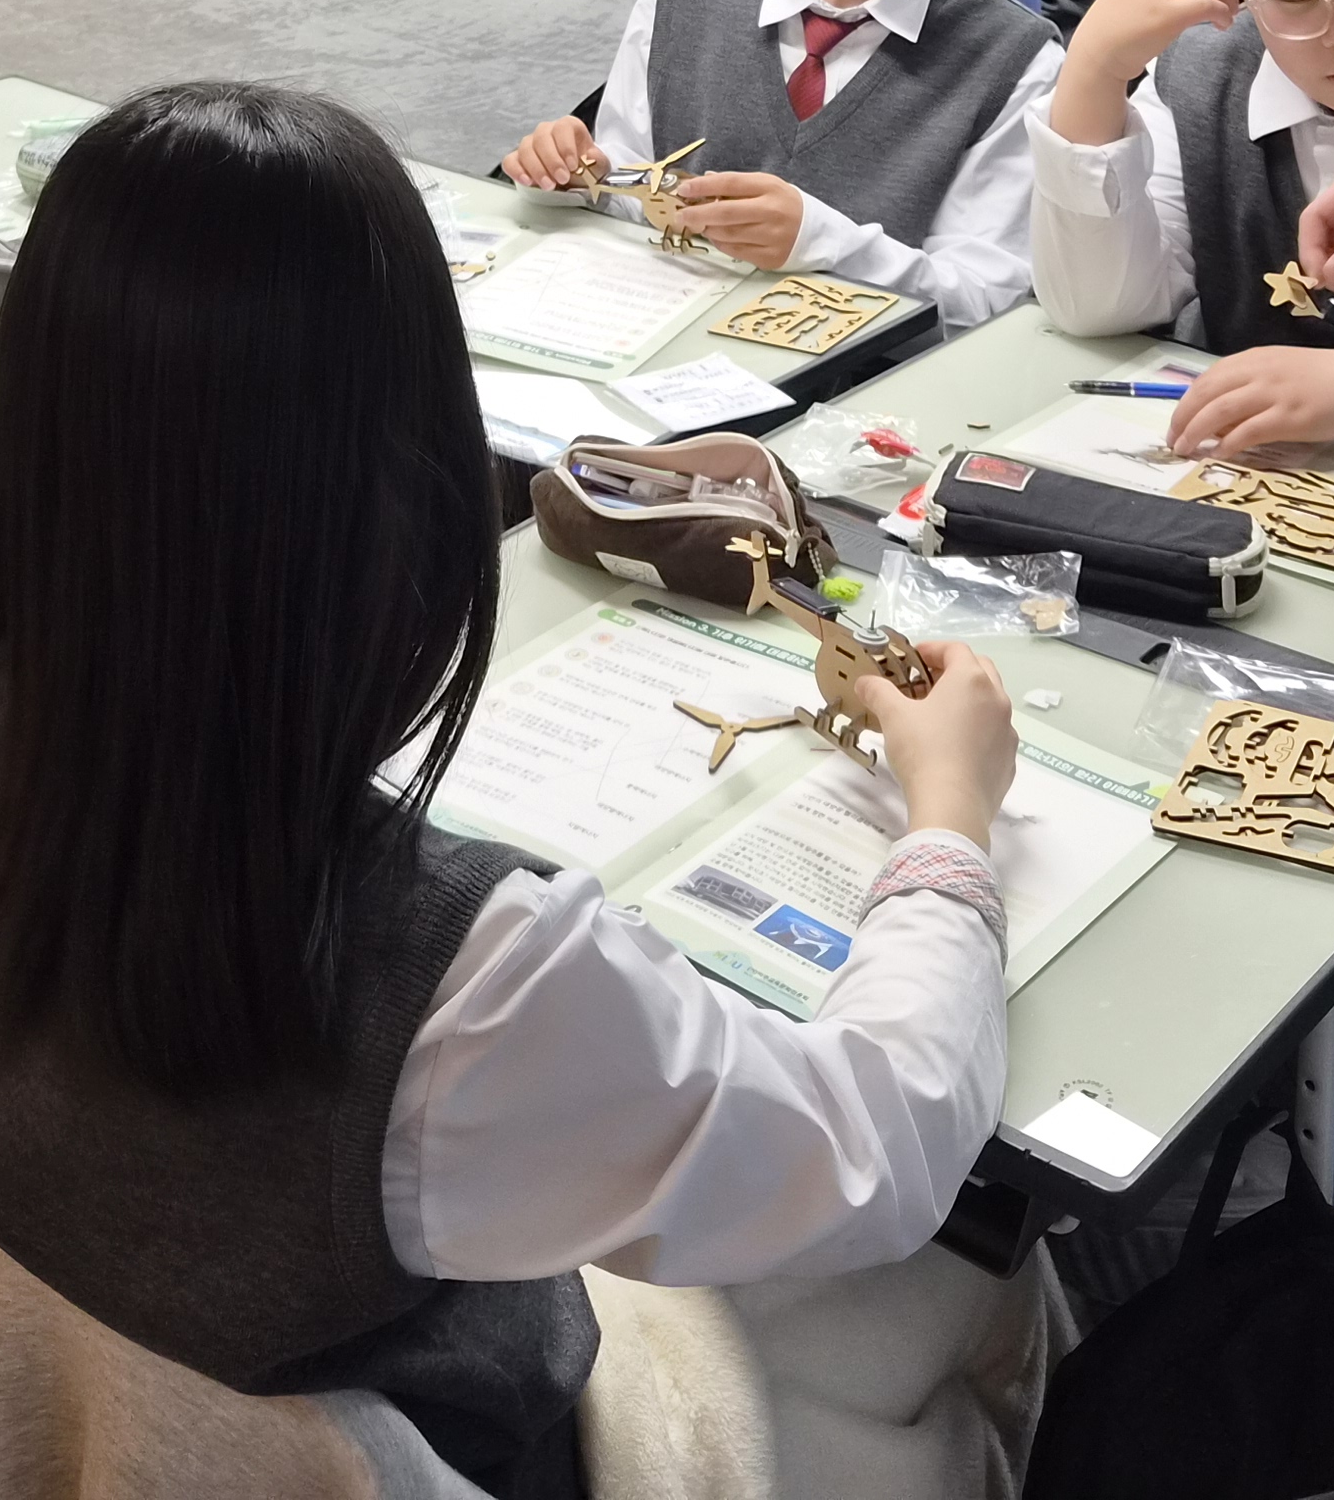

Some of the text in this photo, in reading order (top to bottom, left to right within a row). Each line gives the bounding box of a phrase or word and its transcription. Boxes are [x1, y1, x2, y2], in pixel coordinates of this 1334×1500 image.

[656, 605, 811, 668] Mission 3. 기후 위기에 대응하는
[1074, 768, 1103, 785] 원리
[1102, 776, 1156, 806] 이해하기
